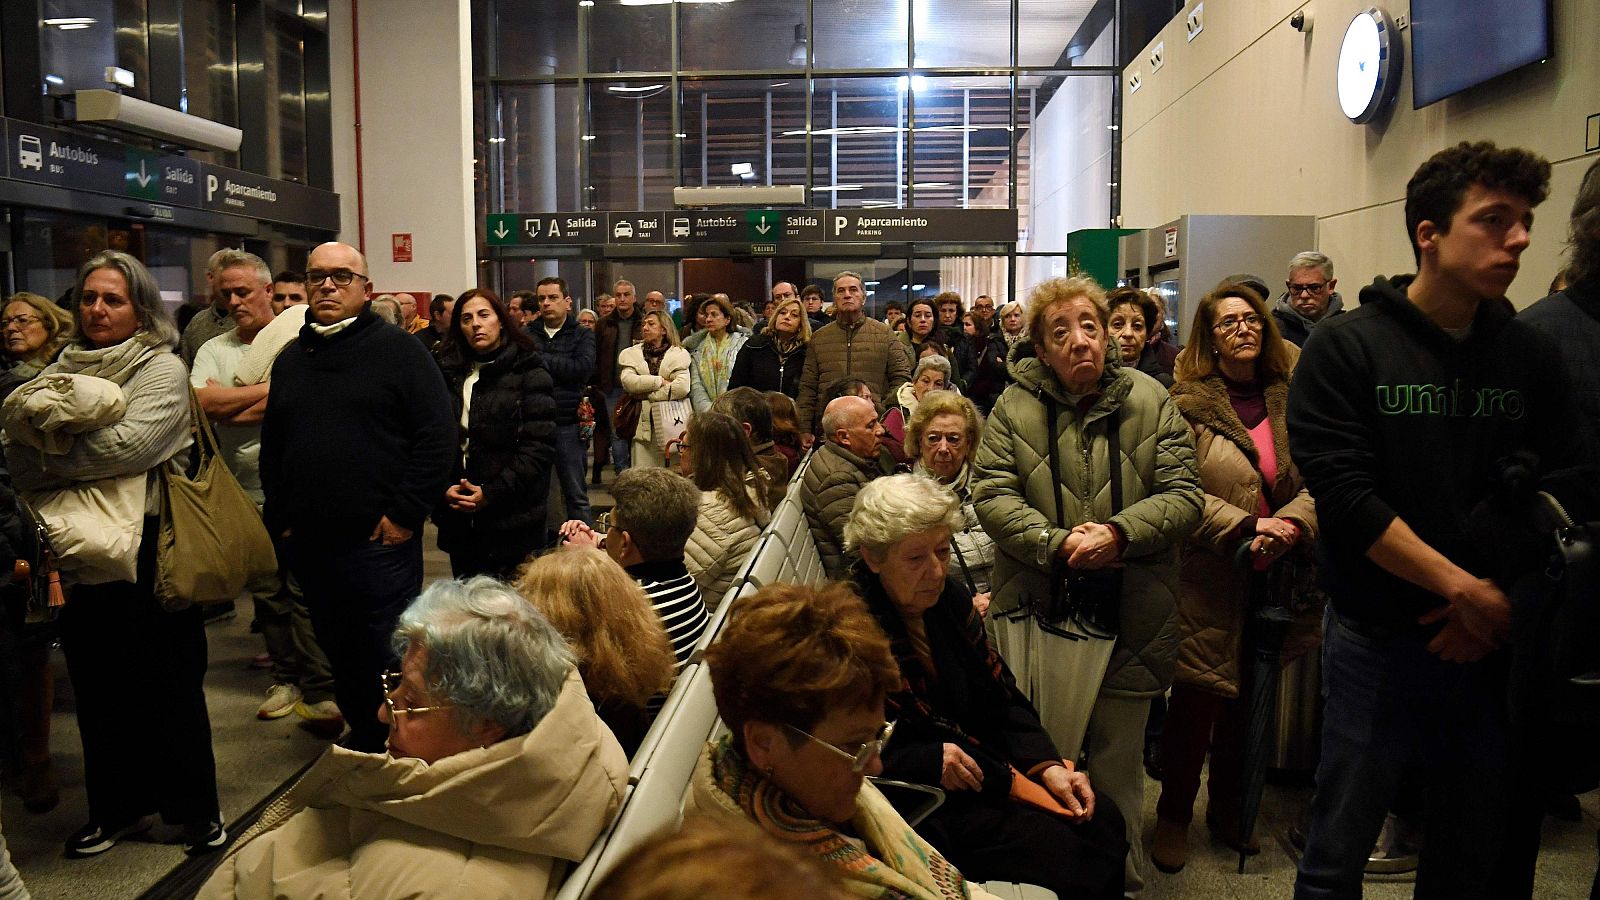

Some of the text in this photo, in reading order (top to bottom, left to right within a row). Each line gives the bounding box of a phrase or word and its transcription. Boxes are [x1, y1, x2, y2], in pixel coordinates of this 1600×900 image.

[49, 141, 99, 165] Autobús
[49, 164, 65, 174] BUS
[165, 166, 194, 184] Salida
[206, 174, 277, 202] P Aparcamiento
[548, 217, 597, 237] A Salida
[638, 218, 658, 229] Taxi
[696, 216, 737, 227] Autobús
[786, 216, 818, 226] Salida
[835, 216, 928, 236] P Aparcamiento
[1375, 378, 1525, 421] umbro
